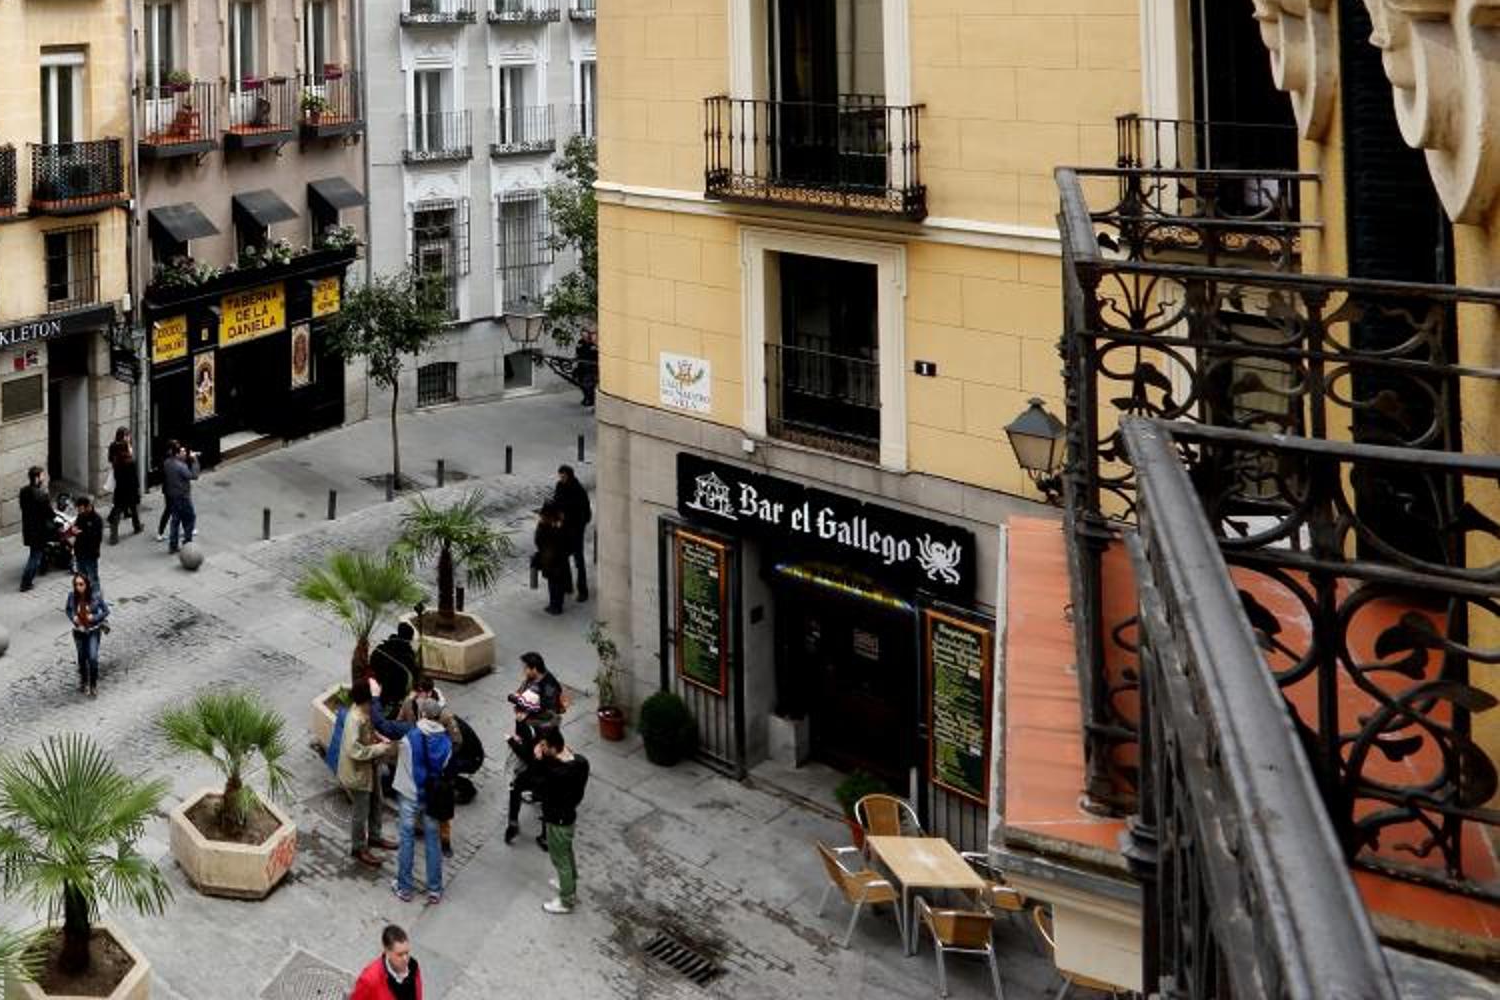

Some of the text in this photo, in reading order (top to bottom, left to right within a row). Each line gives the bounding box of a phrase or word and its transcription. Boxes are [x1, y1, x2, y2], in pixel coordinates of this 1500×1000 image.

[227, 289, 277, 309] TABERNA
[235, 304, 269, 322] DE LA
[227, 315, 277, 338] DANIELA
[737, 481, 911, 565] Bar el Gallego
